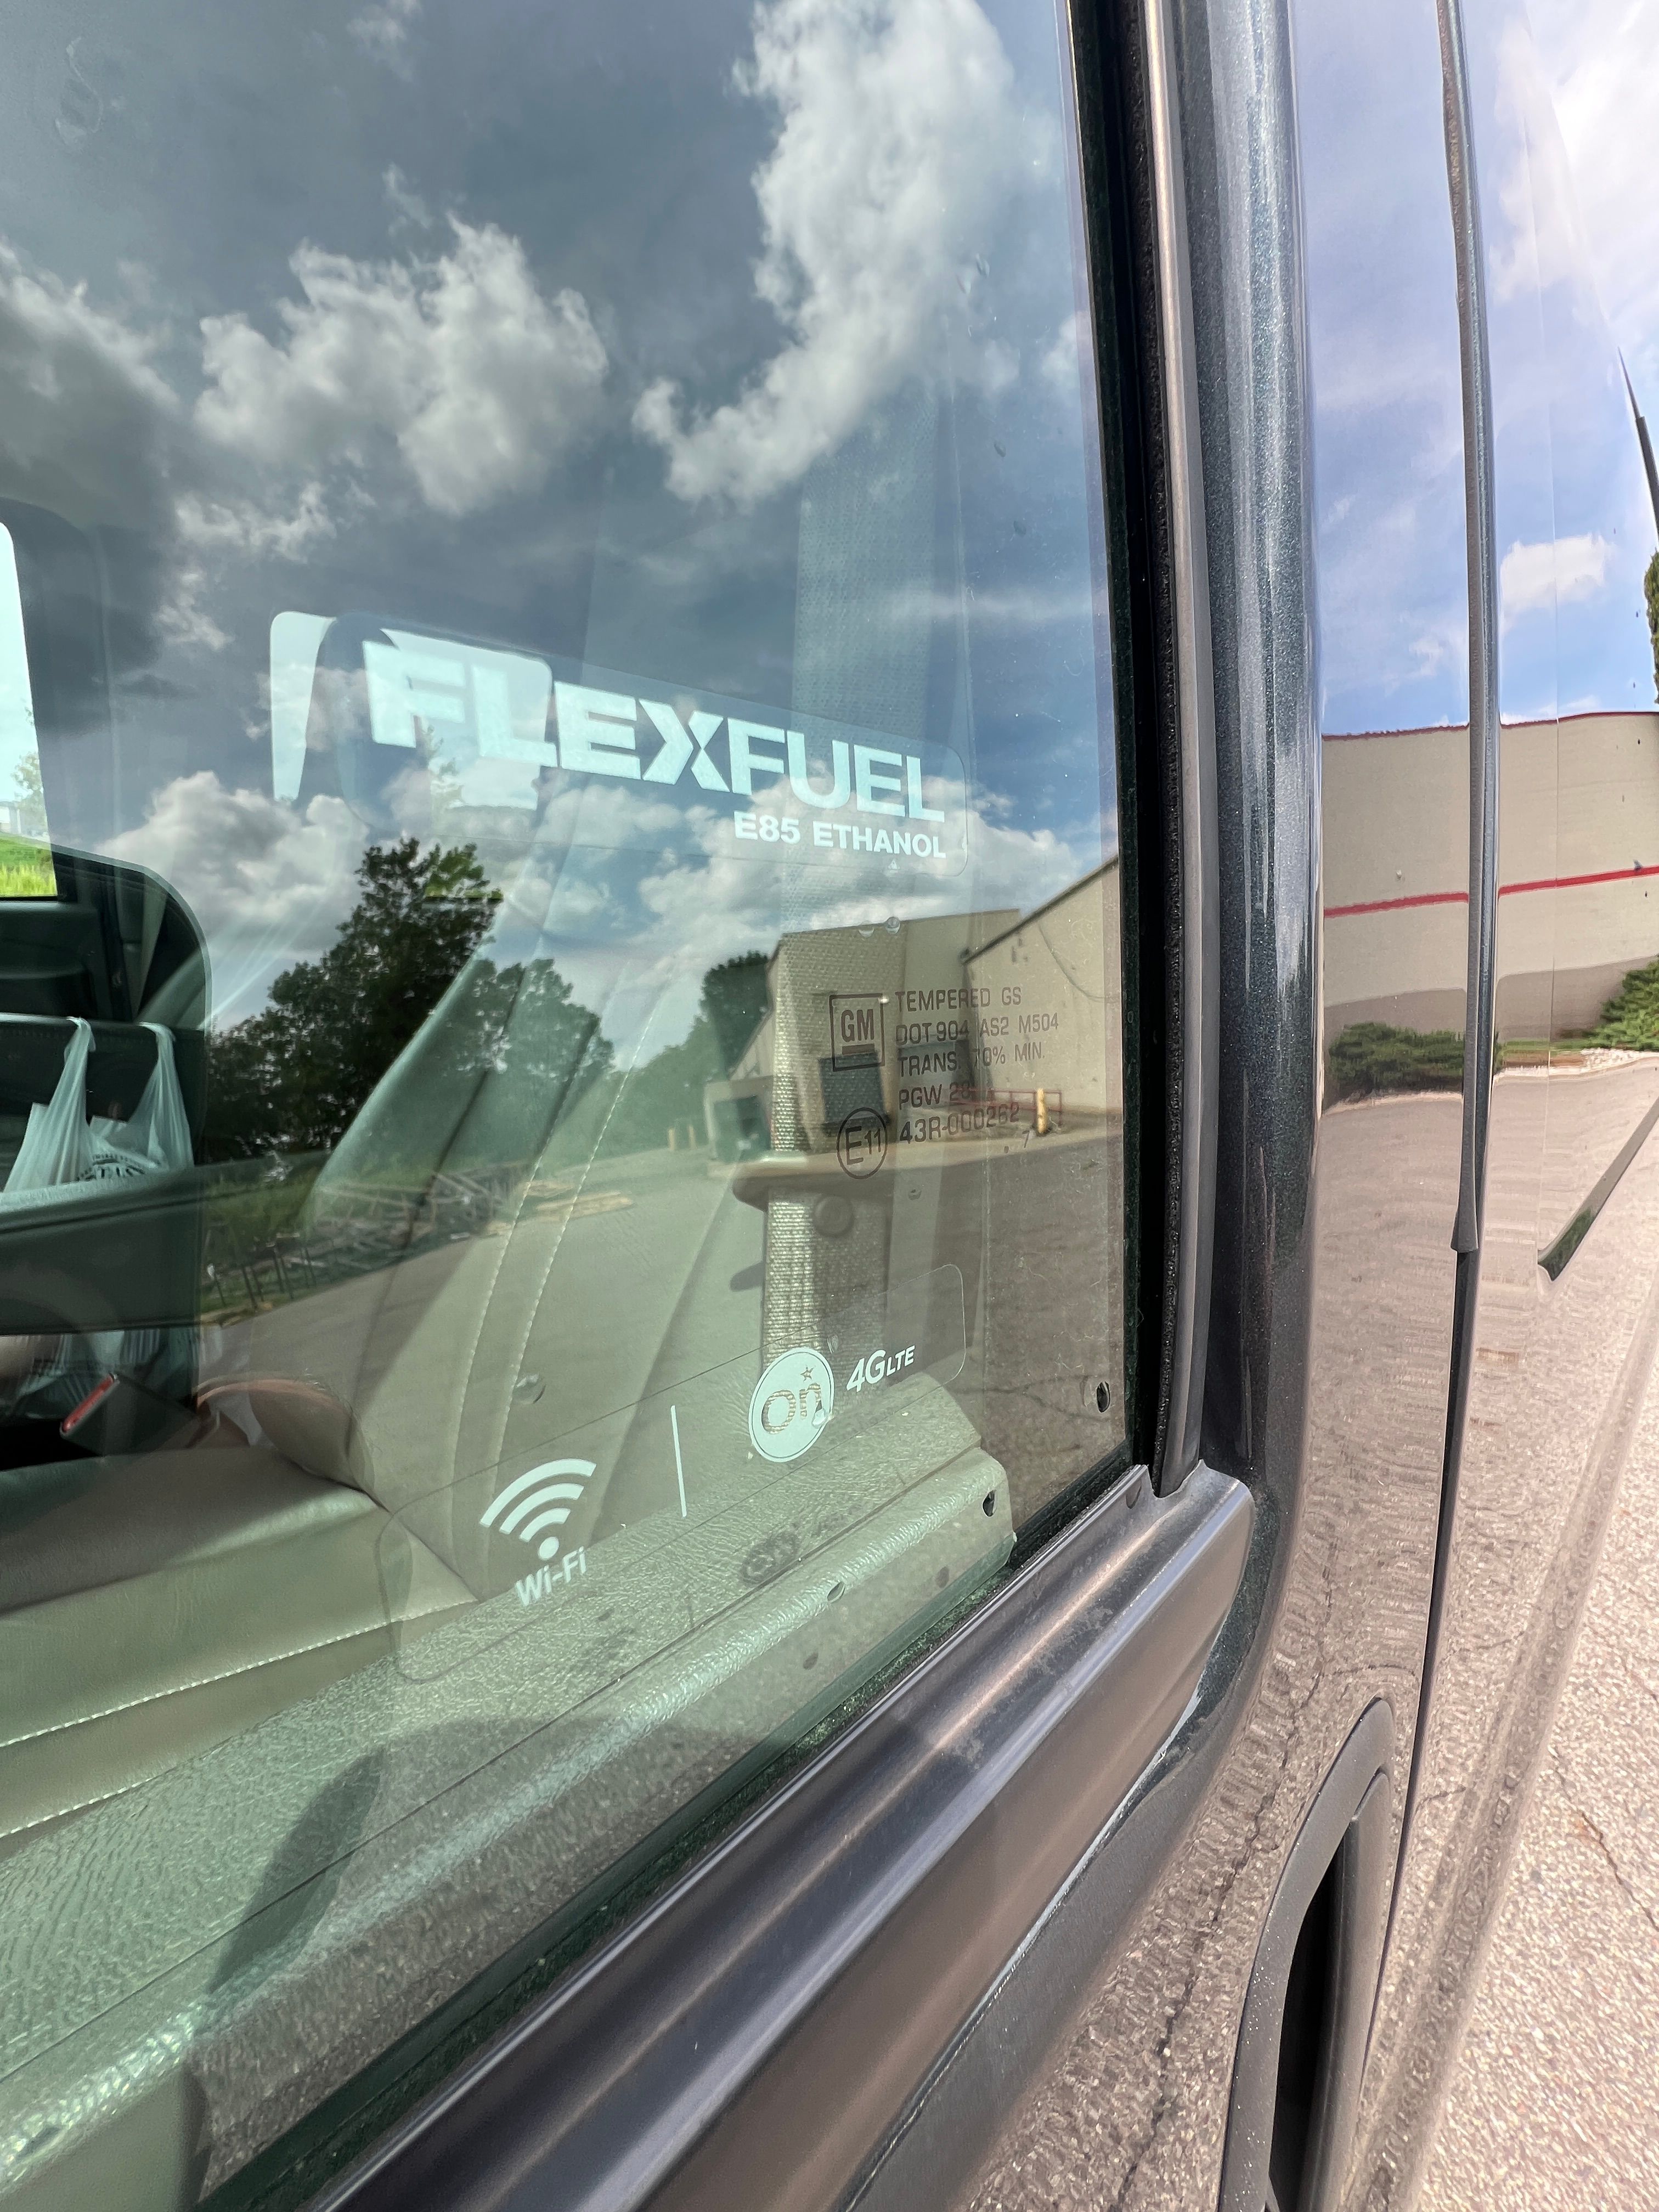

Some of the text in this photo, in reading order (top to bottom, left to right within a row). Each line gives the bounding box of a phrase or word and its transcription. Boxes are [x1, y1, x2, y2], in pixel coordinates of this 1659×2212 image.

[363, 640, 946, 823] FLEXFUEL
[733, 809, 947, 859] E85 ETHANOL
[895, 986, 1022, 1013] TEMPERED GS
[840, 1008, 875, 1043] GM
[895, 1012, 1059, 1045] DOT 904 AS2 M504
[898, 1051, 961, 1077] TRANS.
[1014, 1041, 1045, 1062] MIN.
[898, 1084, 943, 1110] PGW
[899, 1101, 1020, 1145] 43R-000262
[514, 1545, 587, 1607] Wi-Fi
